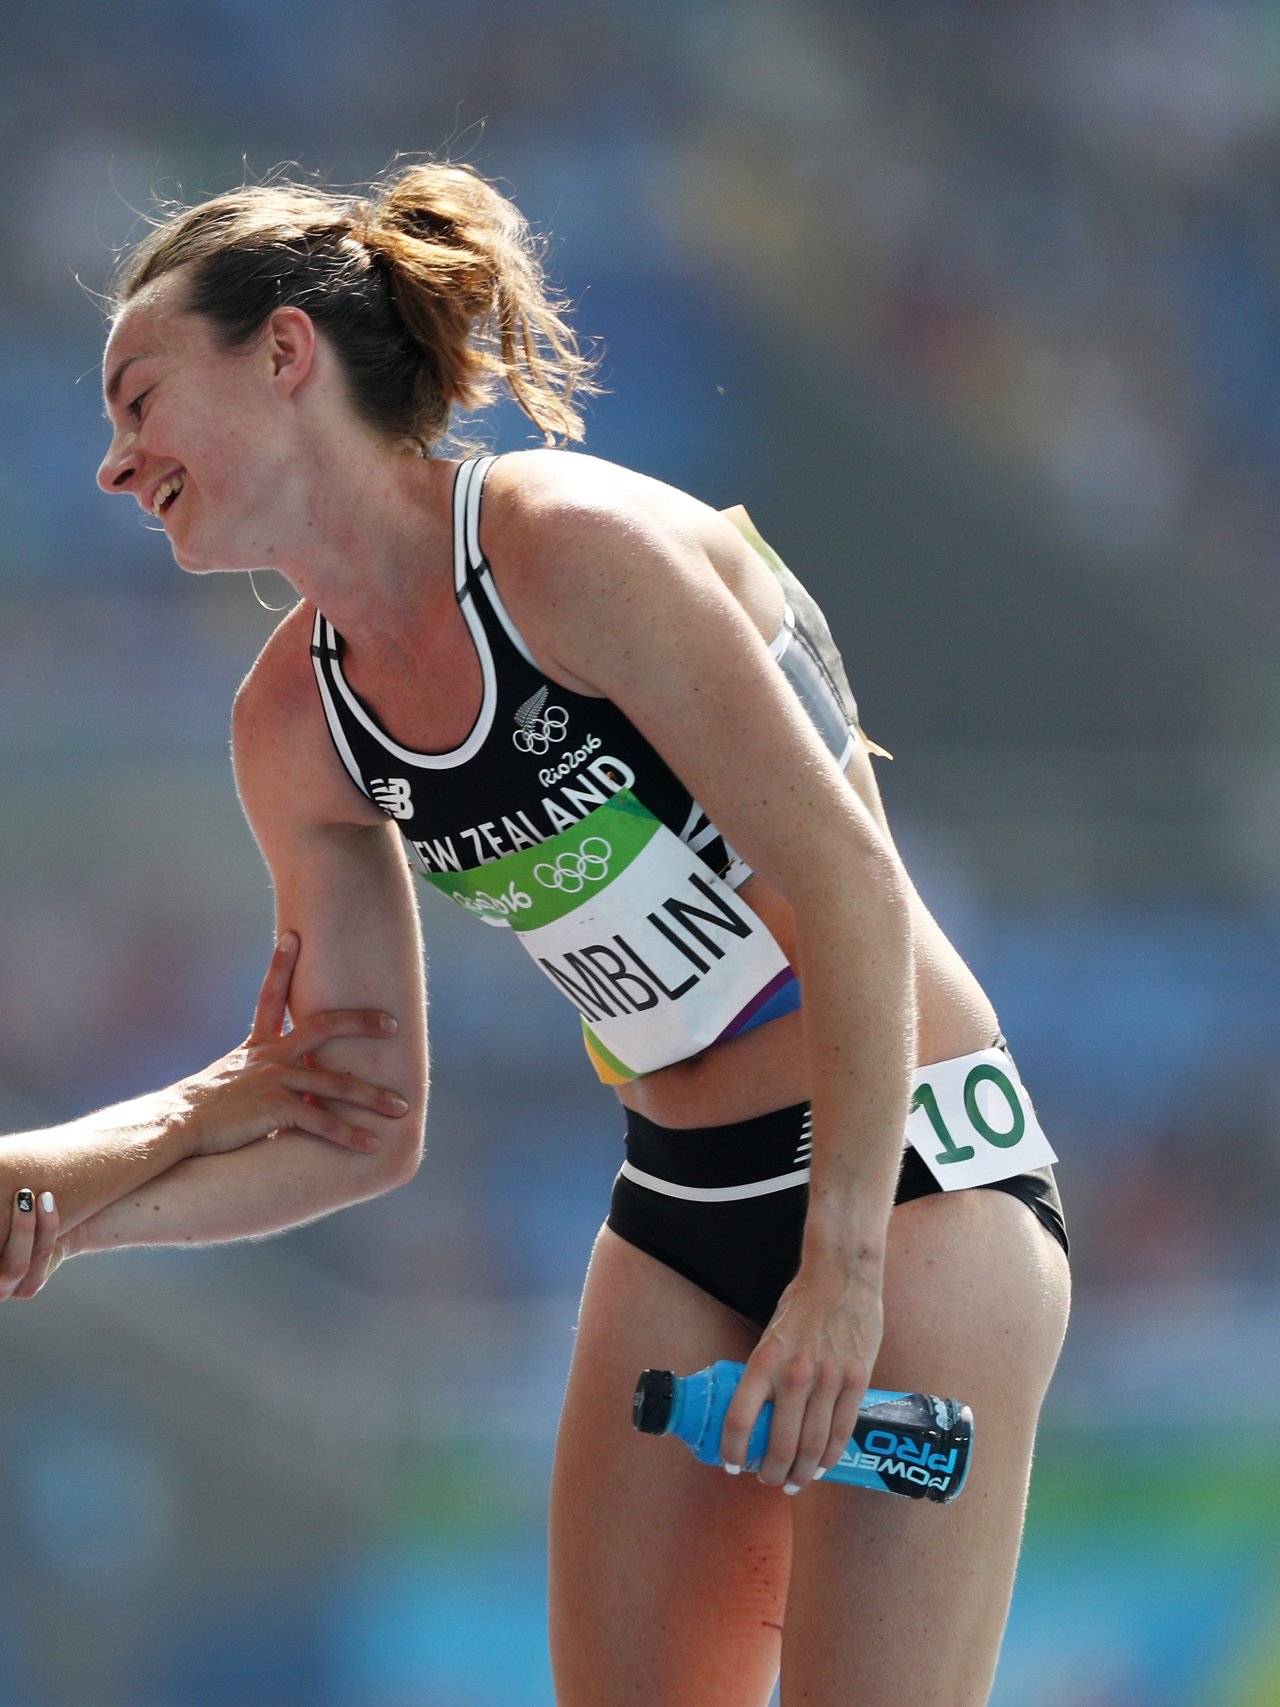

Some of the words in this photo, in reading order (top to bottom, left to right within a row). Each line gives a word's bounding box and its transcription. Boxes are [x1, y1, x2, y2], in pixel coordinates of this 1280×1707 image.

[411, 836, 464, 873] EW
[460, 755, 636, 866] ZEALAND
[538, 872, 753, 1022] MBLIN
[908, 1063, 1025, 1165] 10
[836, 1452, 951, 1491] POWER
[865, 1429, 958, 1474] PRO
